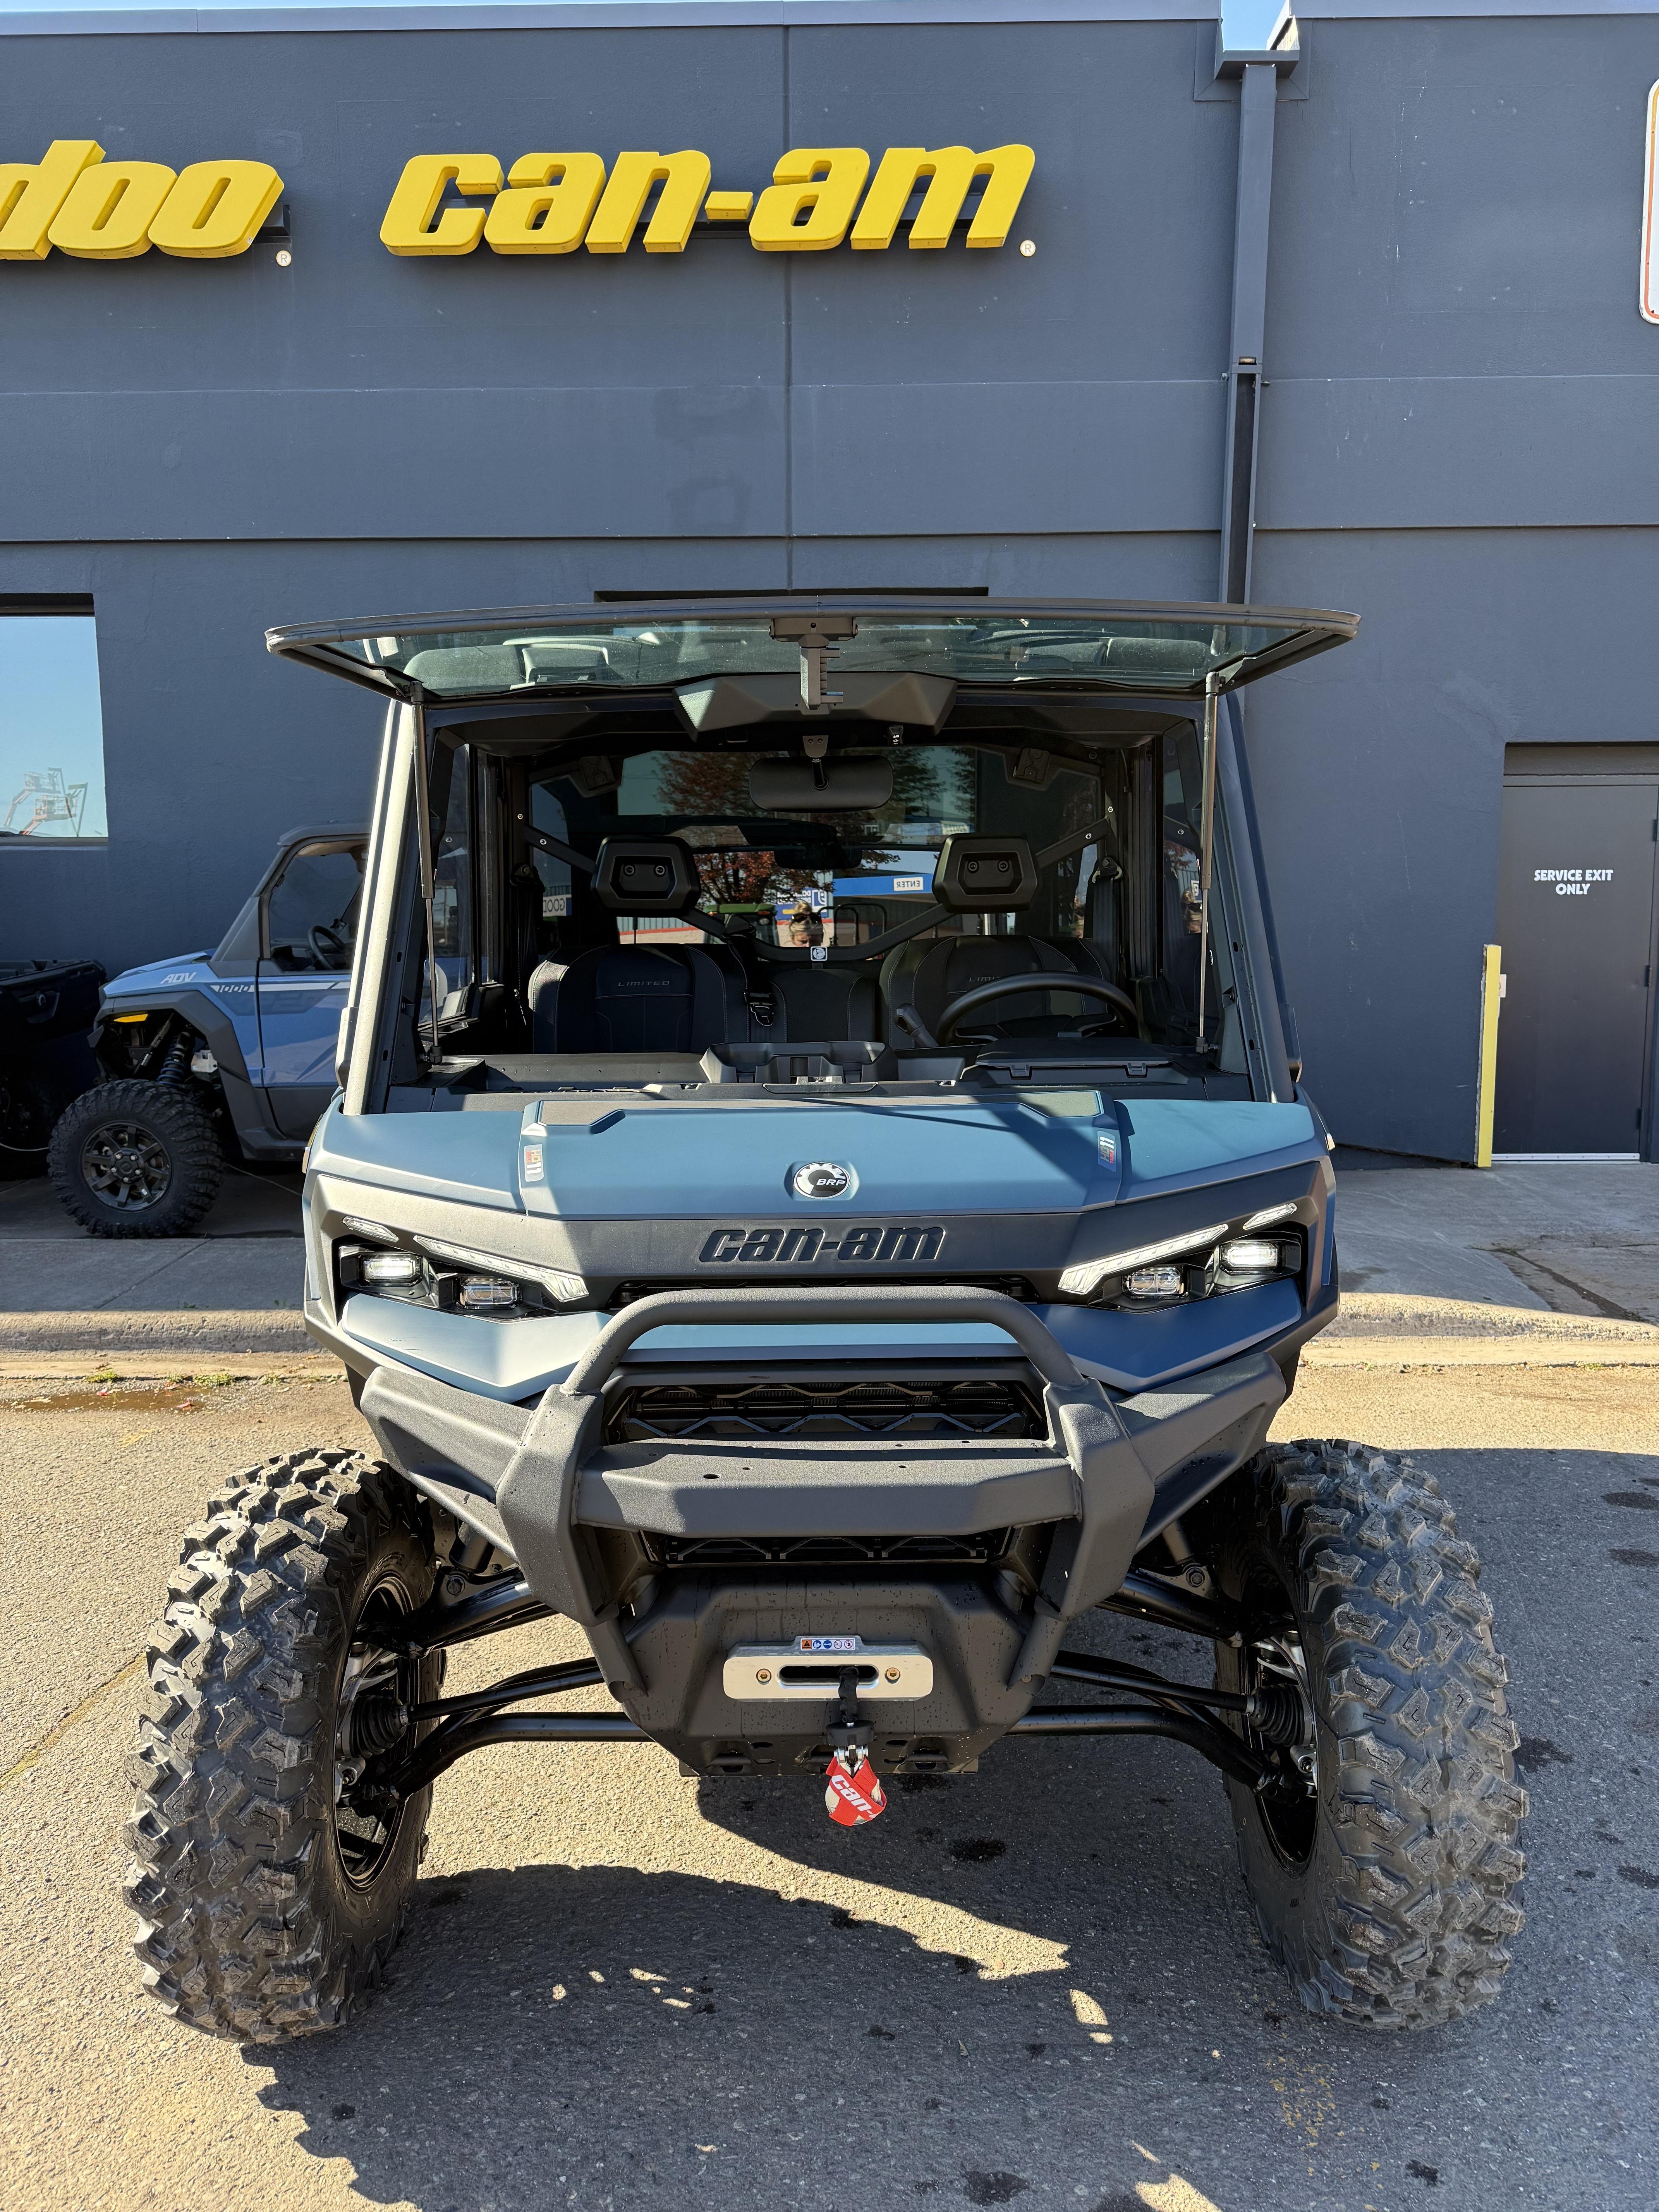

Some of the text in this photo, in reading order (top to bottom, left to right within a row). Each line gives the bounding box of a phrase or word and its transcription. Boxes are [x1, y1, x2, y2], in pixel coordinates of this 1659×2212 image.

[380, 144, 1034, 256] can-am
[1534, 869, 1614, 881] SERVICE EXIT
[1556, 883, 1590, 895] ONLY
[160, 972, 197, 984] ADV
[699, 1226, 946, 1263] can-am
[831, 1774, 877, 1819] can-
